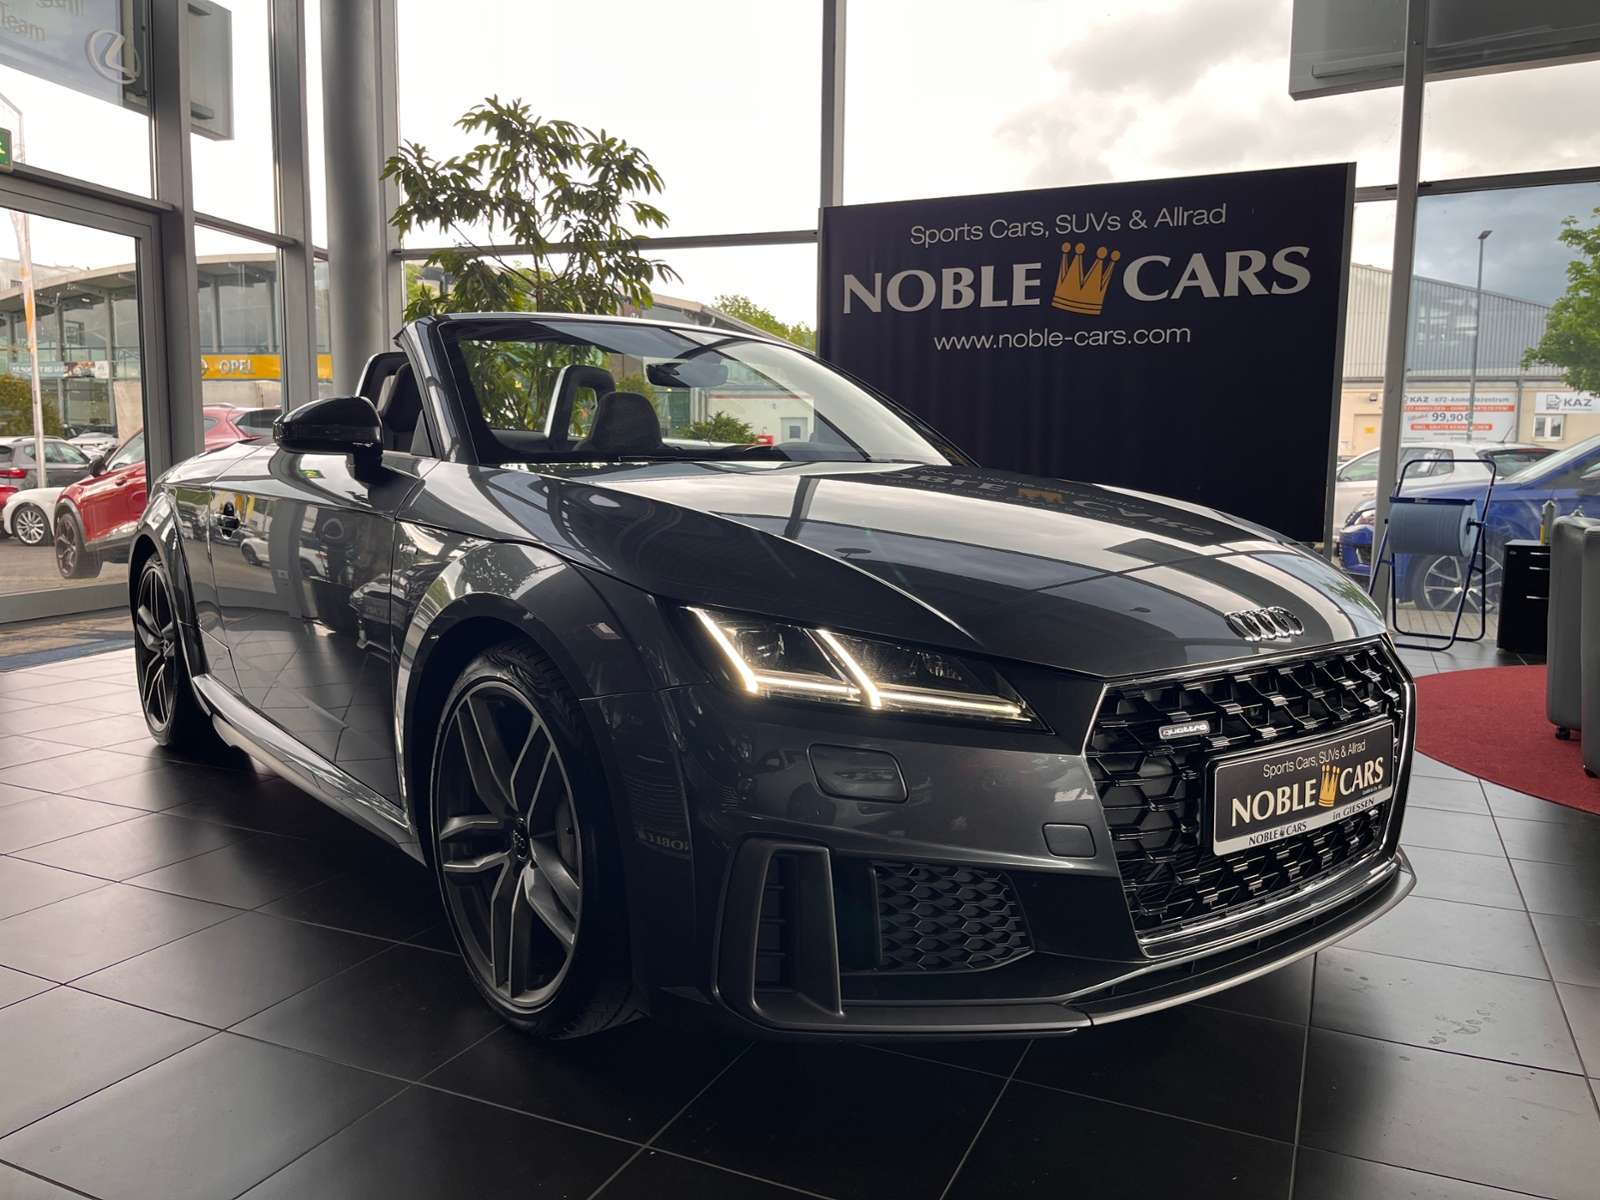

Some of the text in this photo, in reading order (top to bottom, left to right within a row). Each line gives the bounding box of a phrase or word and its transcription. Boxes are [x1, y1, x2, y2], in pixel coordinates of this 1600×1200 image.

[910, 204, 1226, 248] Sports Cars, SUVs & Allrad
[843, 246, 1311, 314] NOBLE CARS
[933, 326, 1191, 350] www.noble-cars.com
[219, 359, 256, 375] OPEL
[1563, 398, 1592, 408] KAZ
[1162, 724, 1208, 737] quattro
[1263, 740, 1366, 779] Sports Cars, SUVs & Allrad
[1231, 757, 1384, 826] NOBLE CARS
[1332, 797, 1375, 821] in GIESSEN
[1248, 821, 1307, 846] NOBLE CARS
